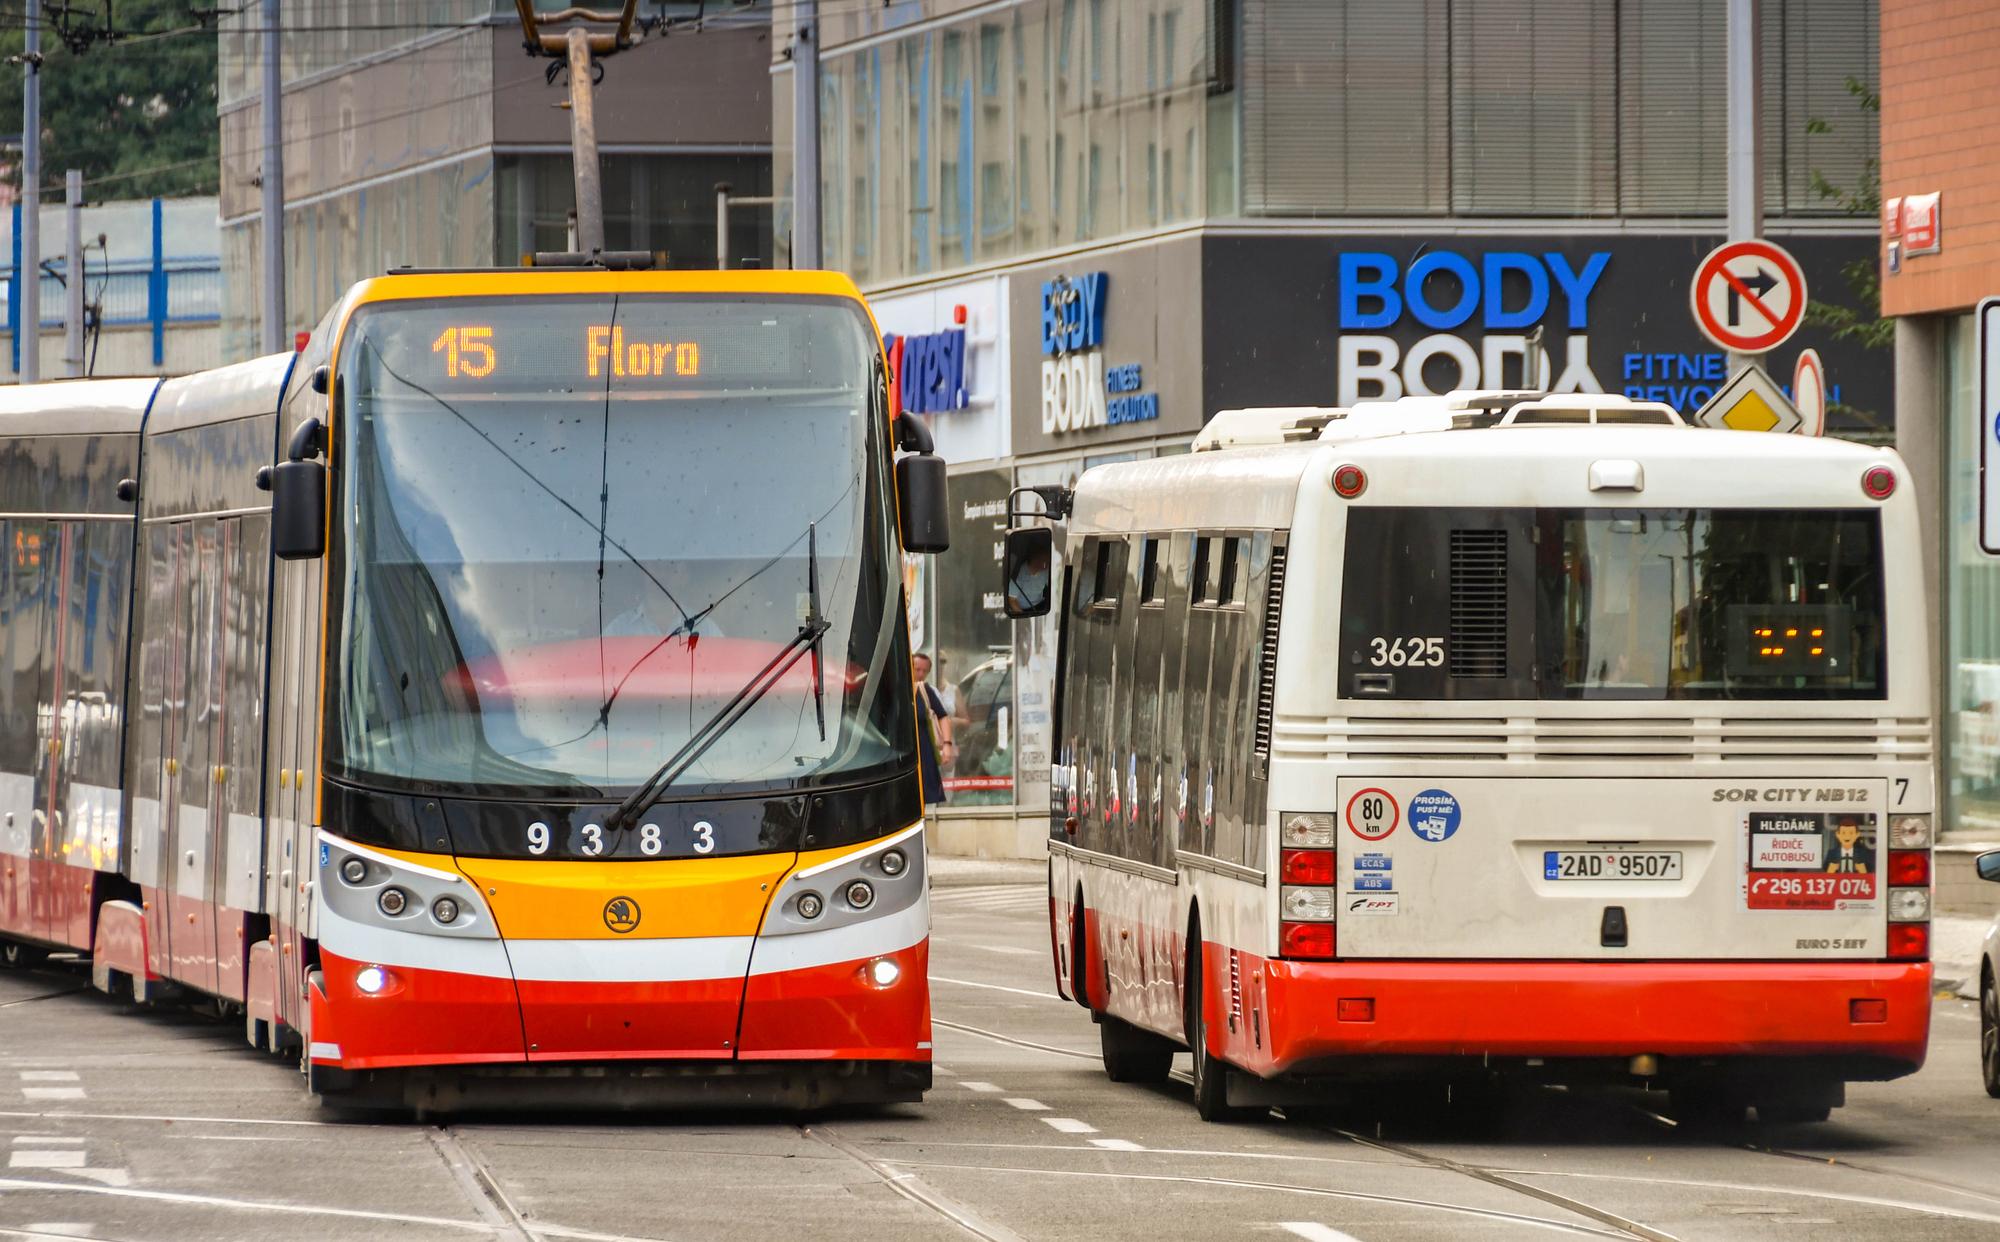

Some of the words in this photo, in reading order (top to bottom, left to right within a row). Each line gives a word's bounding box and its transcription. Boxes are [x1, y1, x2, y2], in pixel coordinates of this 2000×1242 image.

[1338, 250, 1612, 330] BODY
[1041, 271, 1108, 353] BODY
[432, 326, 495, 377] 15
[587, 325, 698, 377] Flora
[1107, 364, 1141, 393] FITNESS
[1108, 393, 1158, 425] REVOLUTION
[1370, 637, 1445, 667] 3625
[1712, 789, 1758, 802] SOR
[1763, 789, 1811, 802] CITY
[1815, 789, 1868, 802] NB12
[1896, 778, 1909, 805] 7
[1363, 798, 1383, 820] 80
[1366, 823, 1380, 833] km
[1760, 819, 1816, 831] HLEDÁME
[1772, 838, 1804, 850] ŘIDIČE
[1361, 859, 1385, 868] ECAS
[1563, 855, 1602, 877] 2AD
[1619, 855, 1671, 877] 9507
[1760, 852, 1815, 862] AUTOBUSU
[1769, 878, 1802, 895] 296
[1806, 878, 1836, 895] 137
[1839, 878, 1871, 895] 074
[1796, 938, 1830, 949] EURO
[1832, 938, 1842, 949] 5
